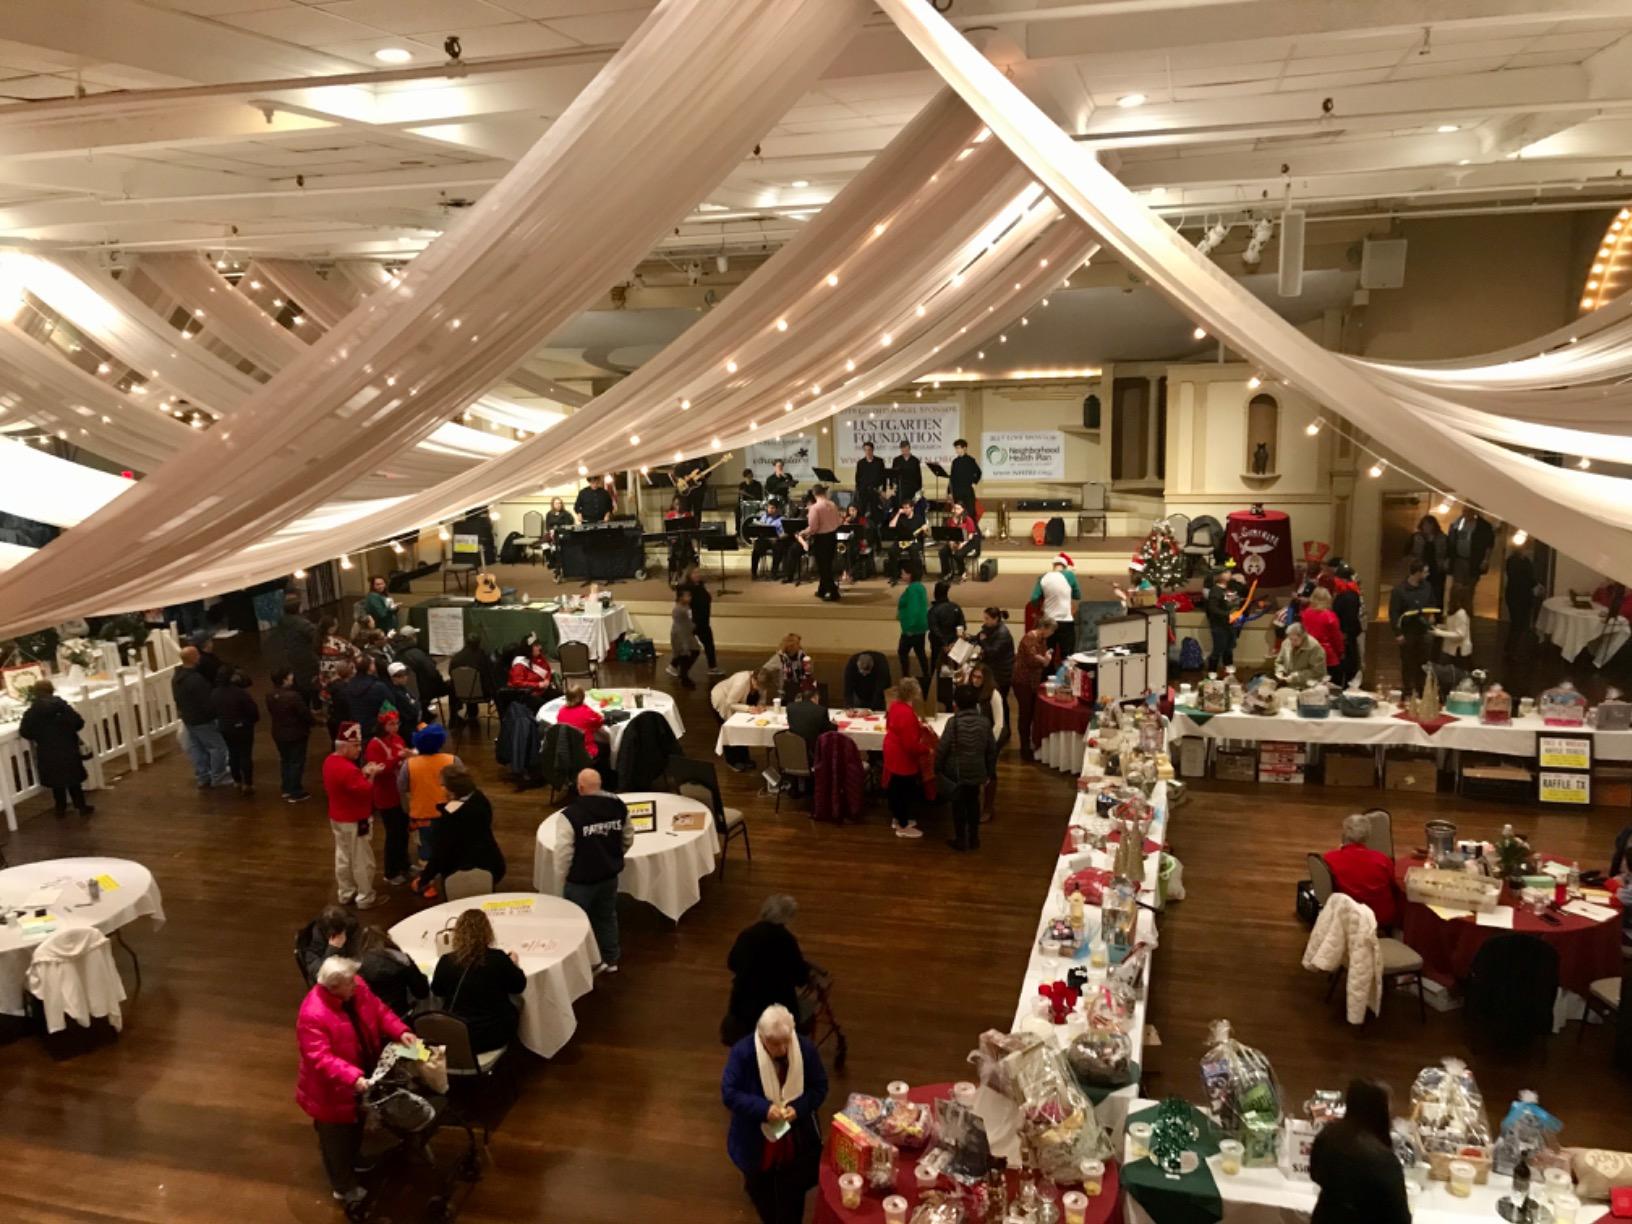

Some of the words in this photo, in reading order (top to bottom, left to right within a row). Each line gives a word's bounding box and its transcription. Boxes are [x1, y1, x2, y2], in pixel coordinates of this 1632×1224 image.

[853, 418, 942, 431] LUSTGARTEN
[853, 431, 942, 444] FOUNDATION
[1009, 446, 1060, 455] Neighborhood
[1009, 453, 1034, 462] Health
[1035, 453, 1052, 461] Plan
[1543, 778, 1571, 790] RAFFLE
